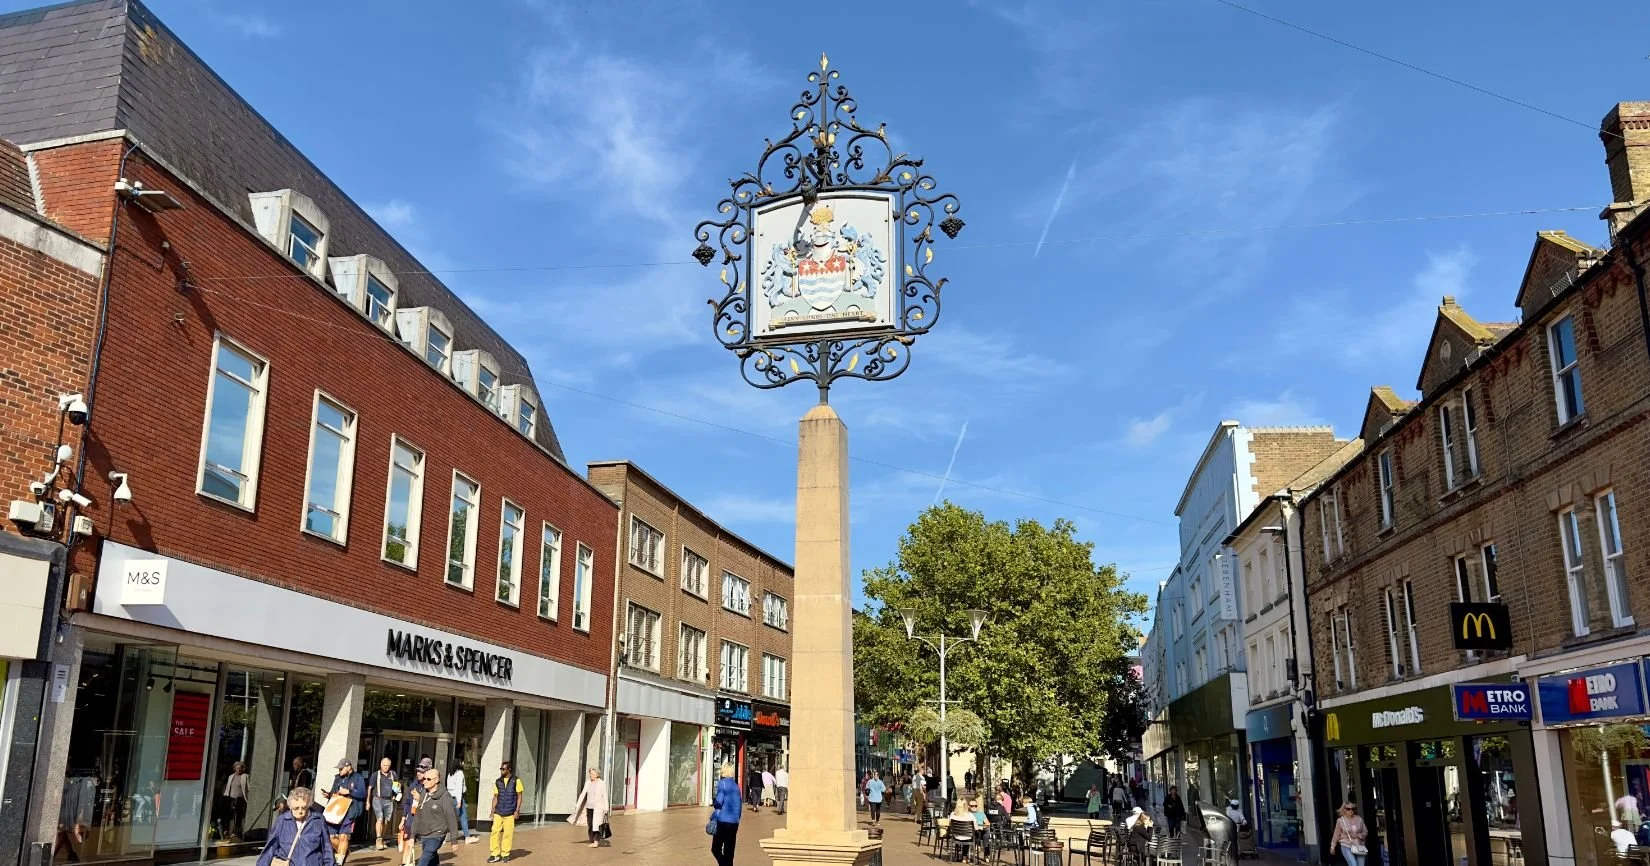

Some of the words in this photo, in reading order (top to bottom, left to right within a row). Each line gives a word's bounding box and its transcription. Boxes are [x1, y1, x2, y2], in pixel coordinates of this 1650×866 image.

[127, 571, 161, 585] M&S
[1221, 556, 1233, 618] DEBENHAMS
[1462, 688, 1525, 714] METRO
[1591, 695, 1619, 712] BANK
[1490, 704, 1528, 714] BANK
[174, 727, 195, 736] SALE
